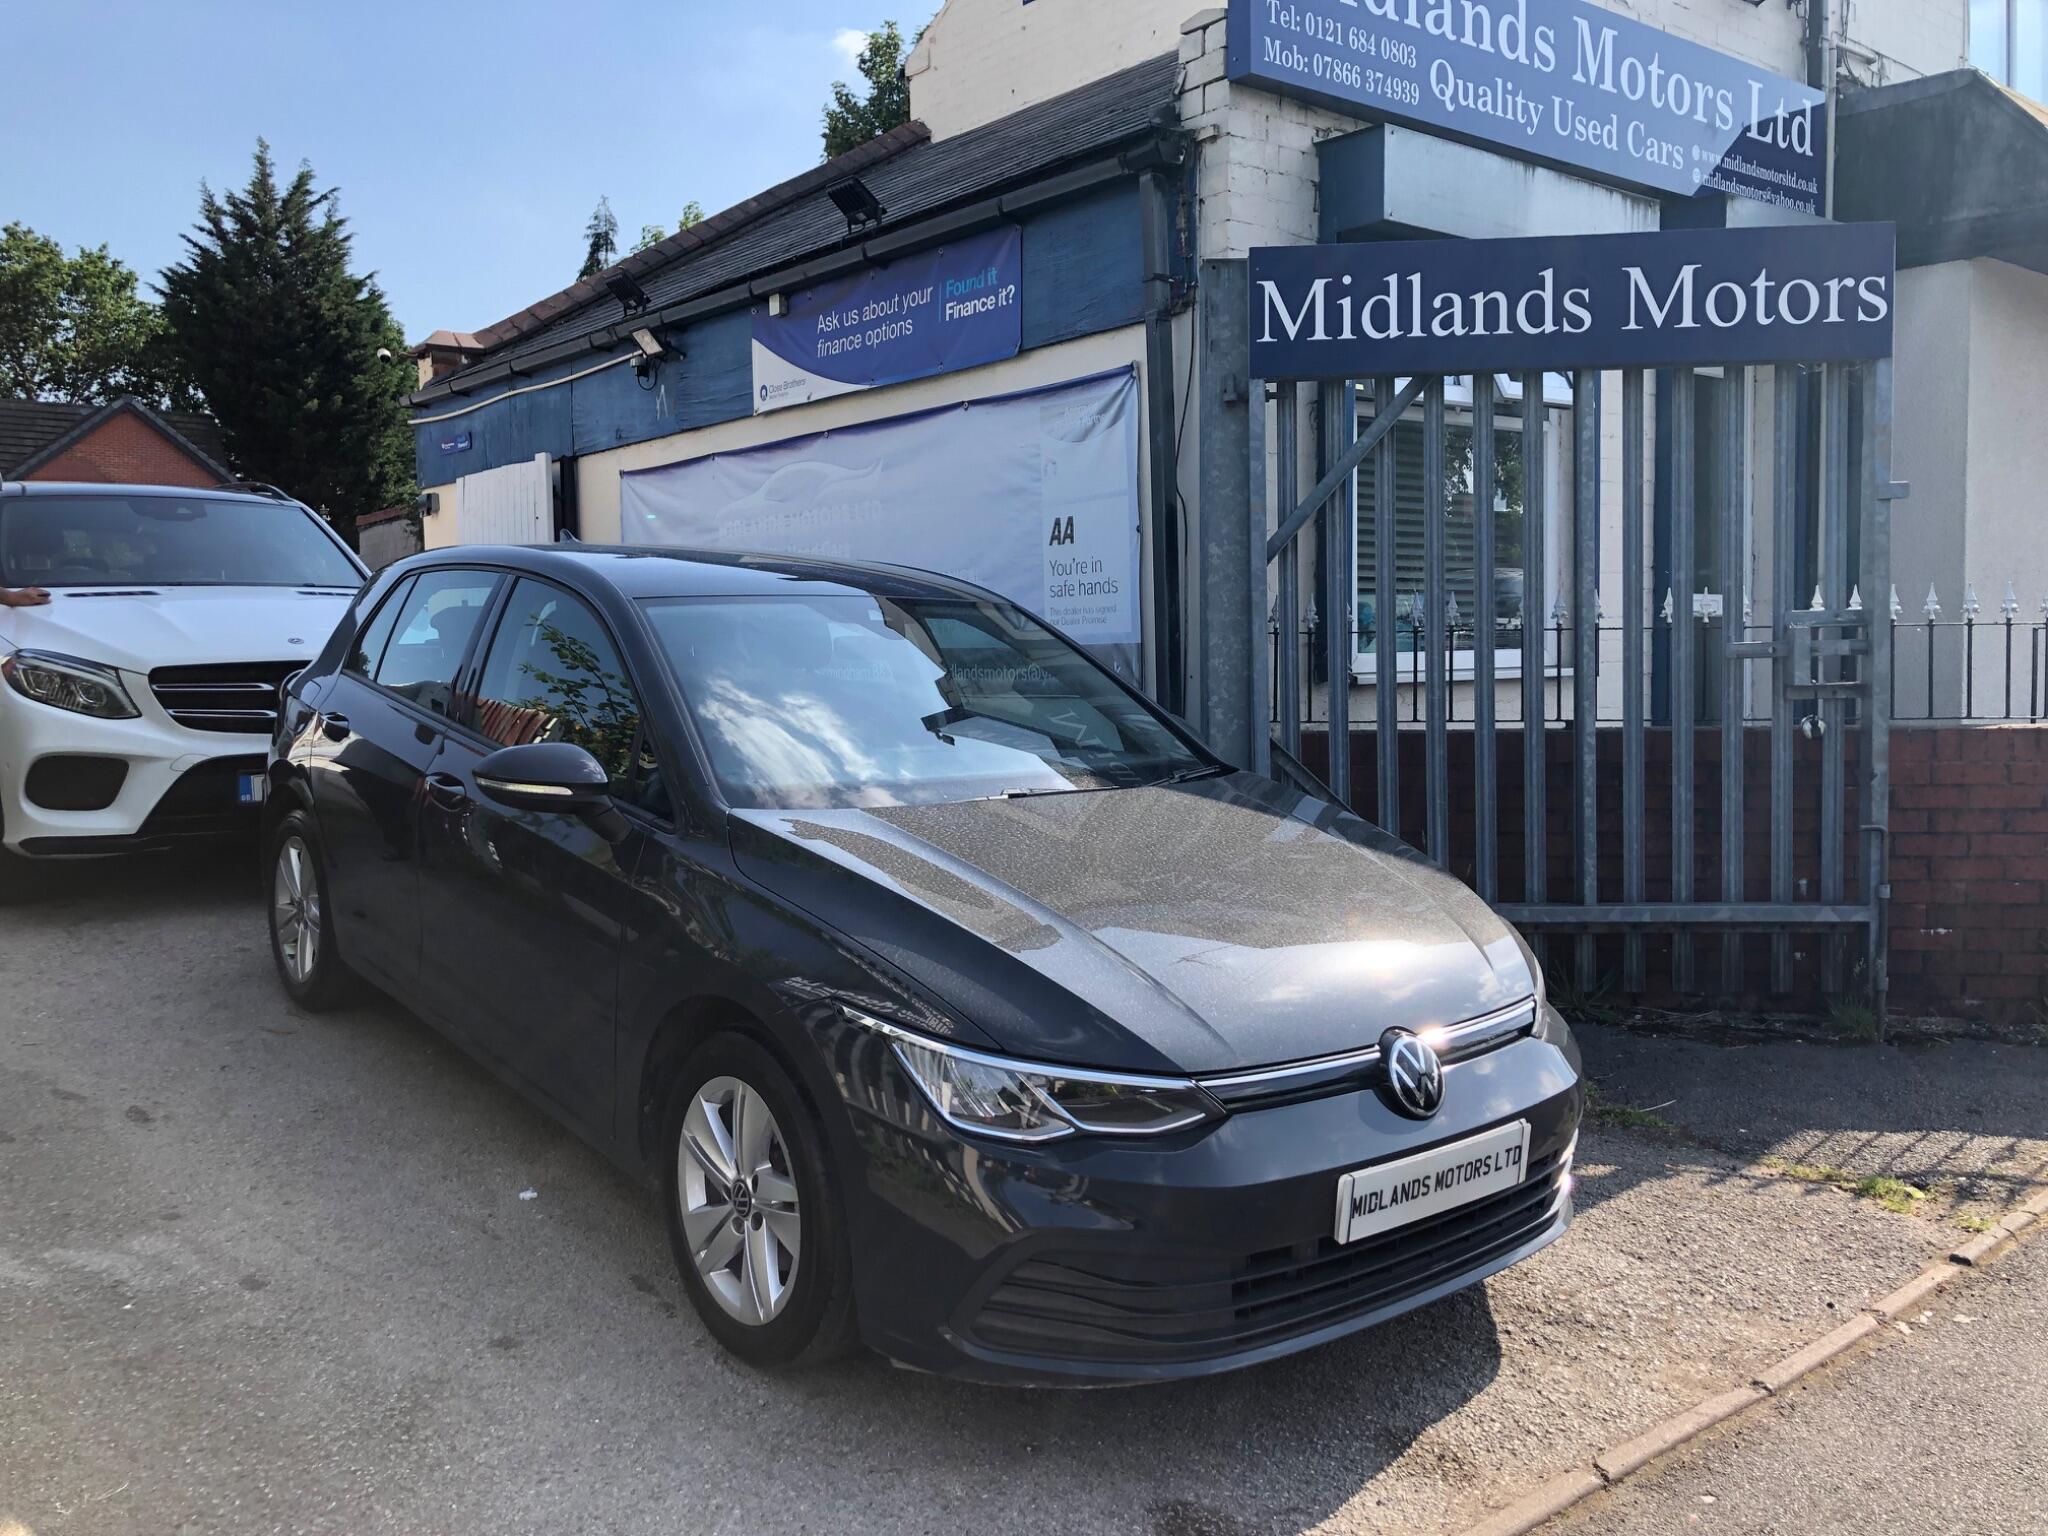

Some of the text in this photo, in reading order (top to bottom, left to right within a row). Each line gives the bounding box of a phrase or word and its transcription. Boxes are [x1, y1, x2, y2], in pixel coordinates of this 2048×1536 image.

[1266, 0, 1417, 69] Tel: 0121 684 0803
[1263, 35, 1420, 106] Mob: 07866 374939
[1572, 15, 1734, 131] Motors
[1746, 78, 1814, 157] Ltd
[1429, 58, 1684, 170] Quality Used Cars
[945, 284, 1016, 322] Finance it?
[946, 266, 999, 298] Found it
[1256, 263, 1889, 343] Midlands Motors
[816, 284, 934, 335] Ask us about your
[816, 318, 914, 360] finance options
[1048, 515, 1075, 546] AA
[1049, 576, 1119, 598] safe hands
[1091, 555, 1103, 574] in
[1351, 1144, 1522, 1219] MIDLANDS MOTORS LTD
